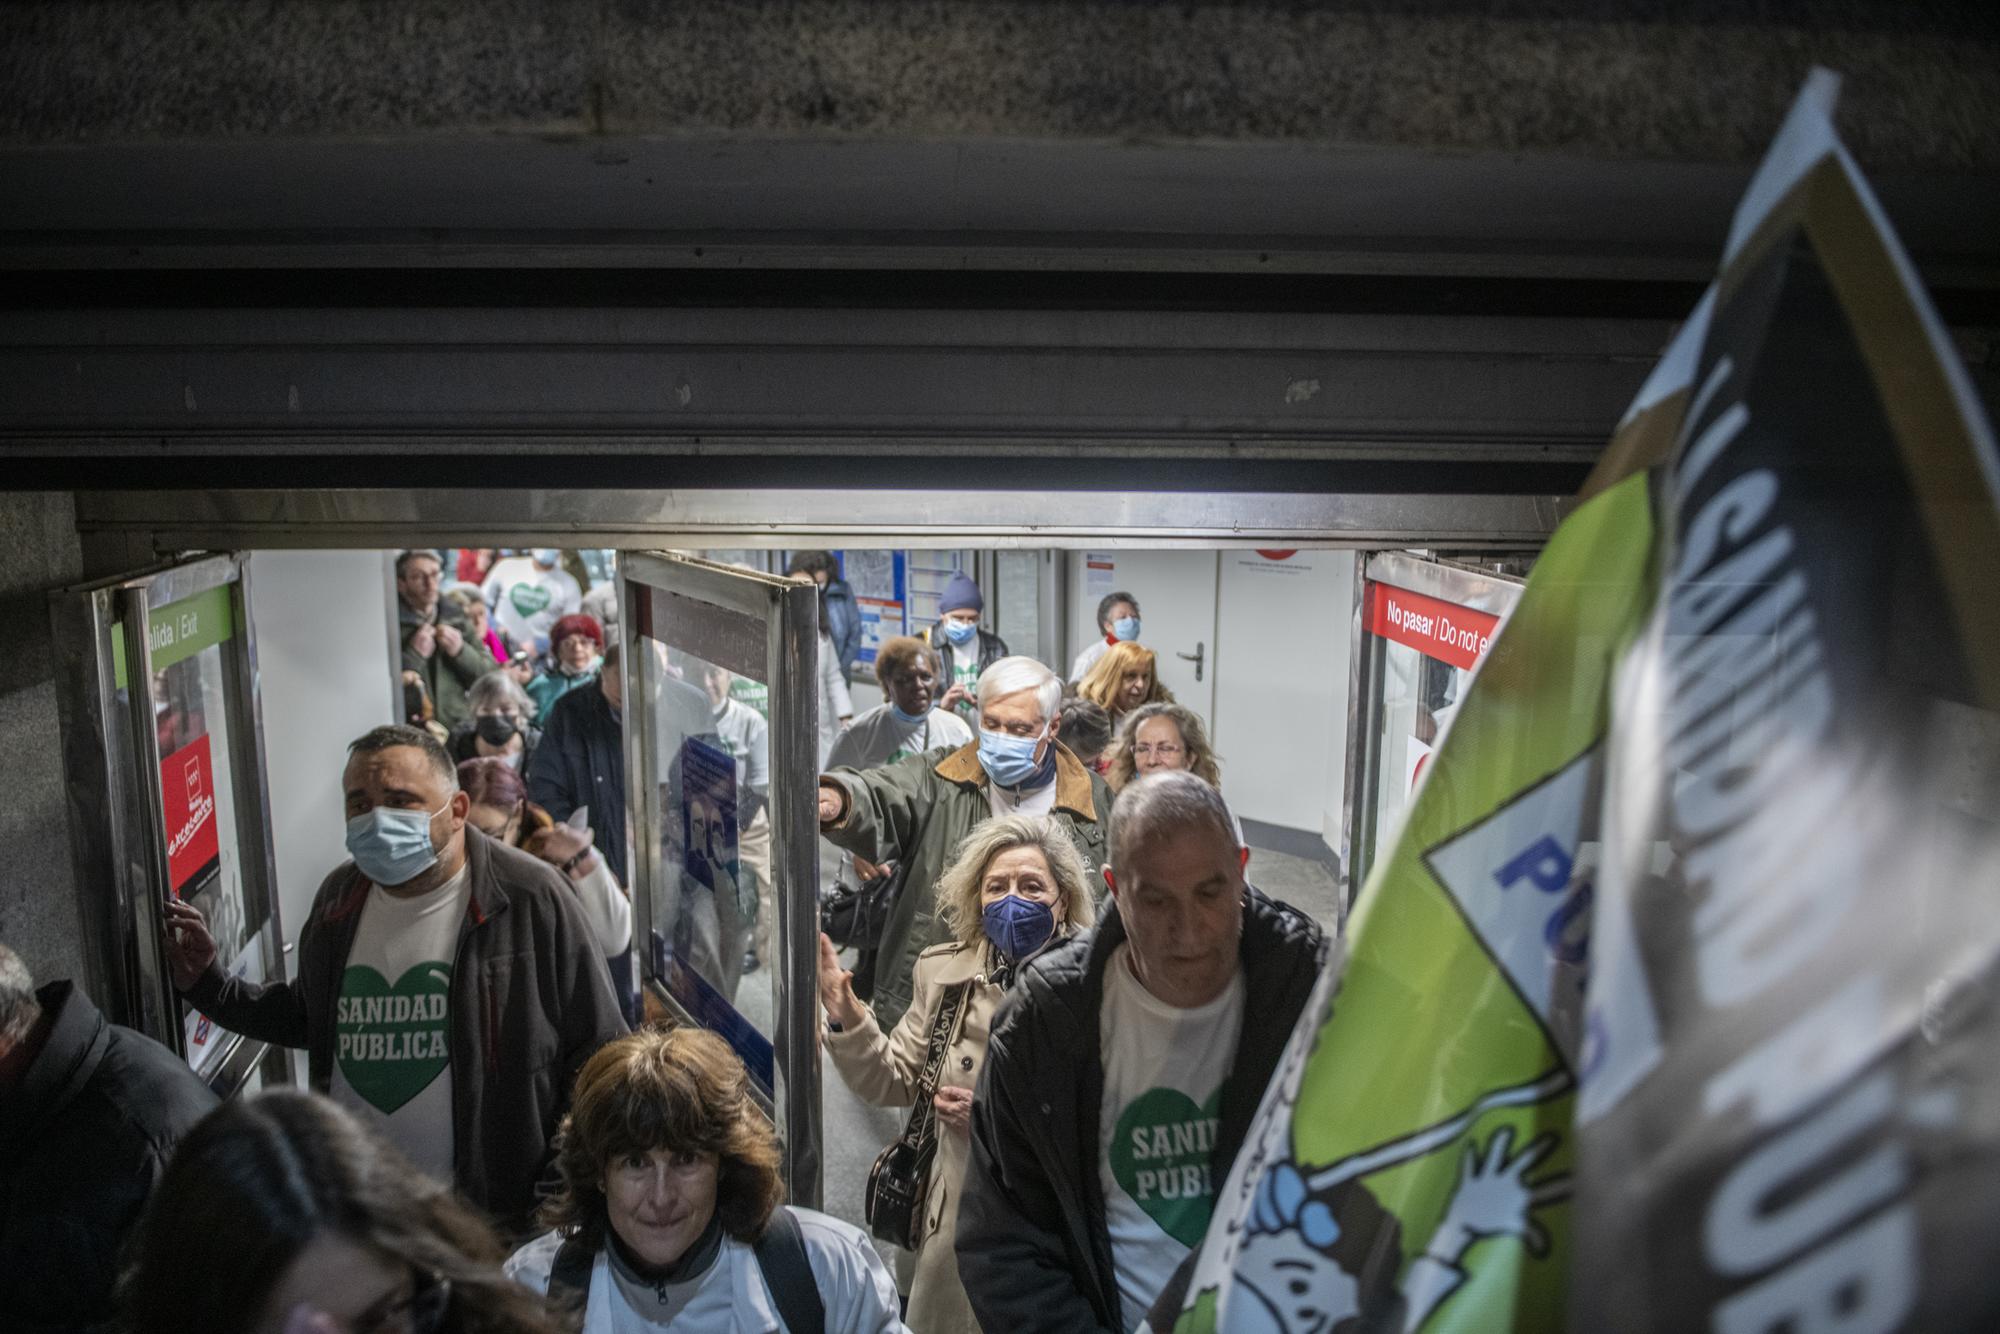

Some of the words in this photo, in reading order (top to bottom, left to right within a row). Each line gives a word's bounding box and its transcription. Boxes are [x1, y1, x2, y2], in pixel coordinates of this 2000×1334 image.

[181, 611, 198, 640] Exit
[1387, 600, 1402, 625] No
[1403, 609, 1434, 637] pasar
[1434, 616, 1440, 641] /
[1440, 617, 1456, 645] Do
[1458, 629, 1479, 654] not
[337, 993, 448, 1024] SANIDAD
[338, 1024, 449, 1060] PÚBLICA
